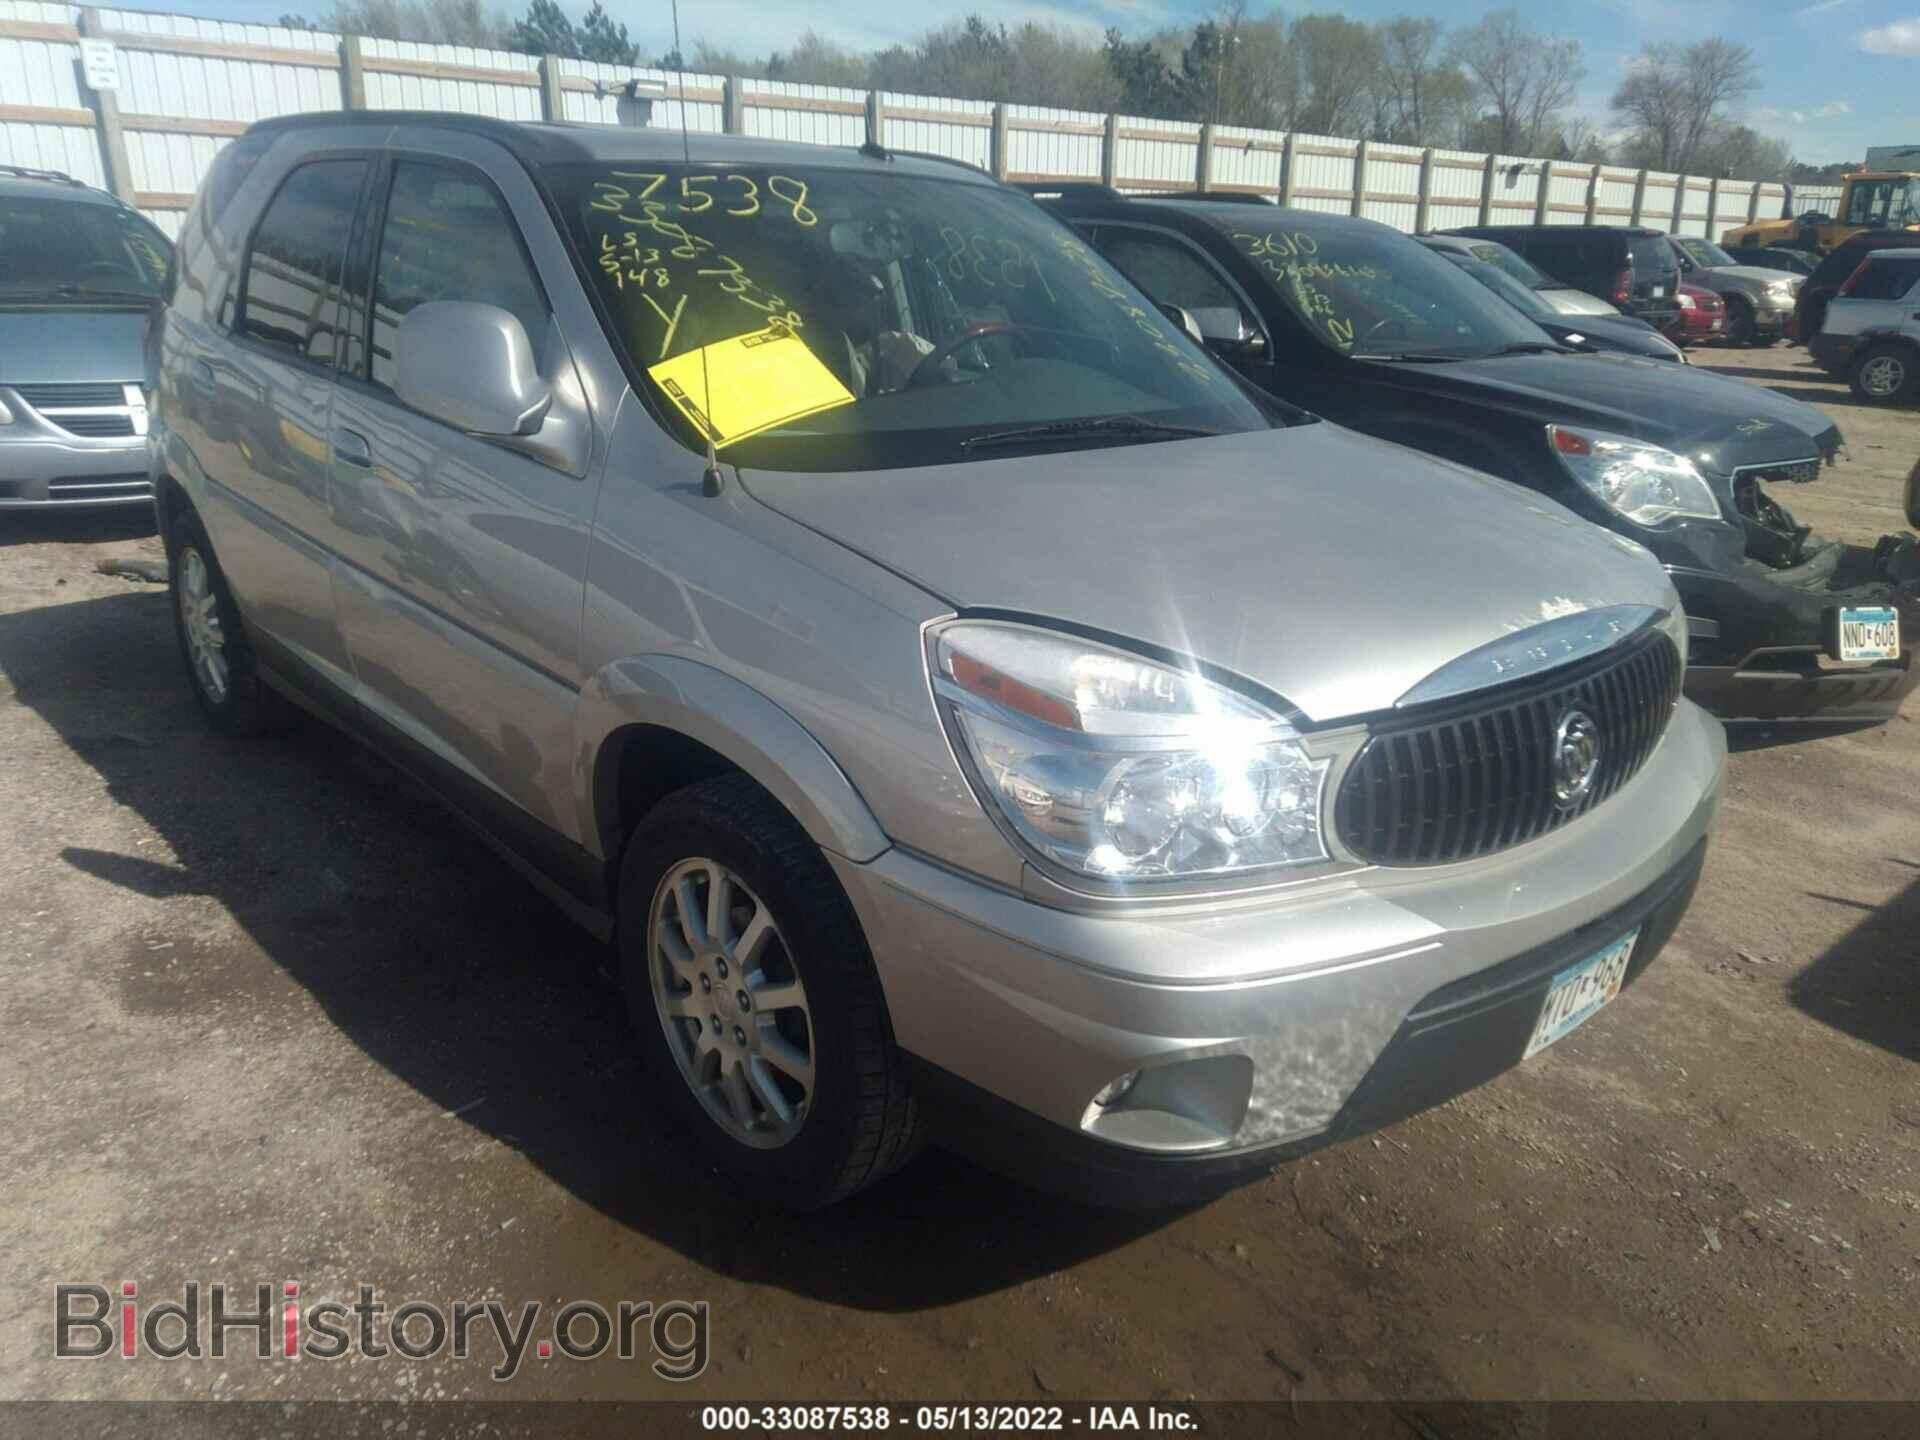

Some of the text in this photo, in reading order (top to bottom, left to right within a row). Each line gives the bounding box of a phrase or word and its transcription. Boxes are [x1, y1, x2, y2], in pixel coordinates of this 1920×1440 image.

[611, 170, 818, 226] 7538
[1233, 232, 1318, 256] 3610
[641, 293, 688, 360] Y
